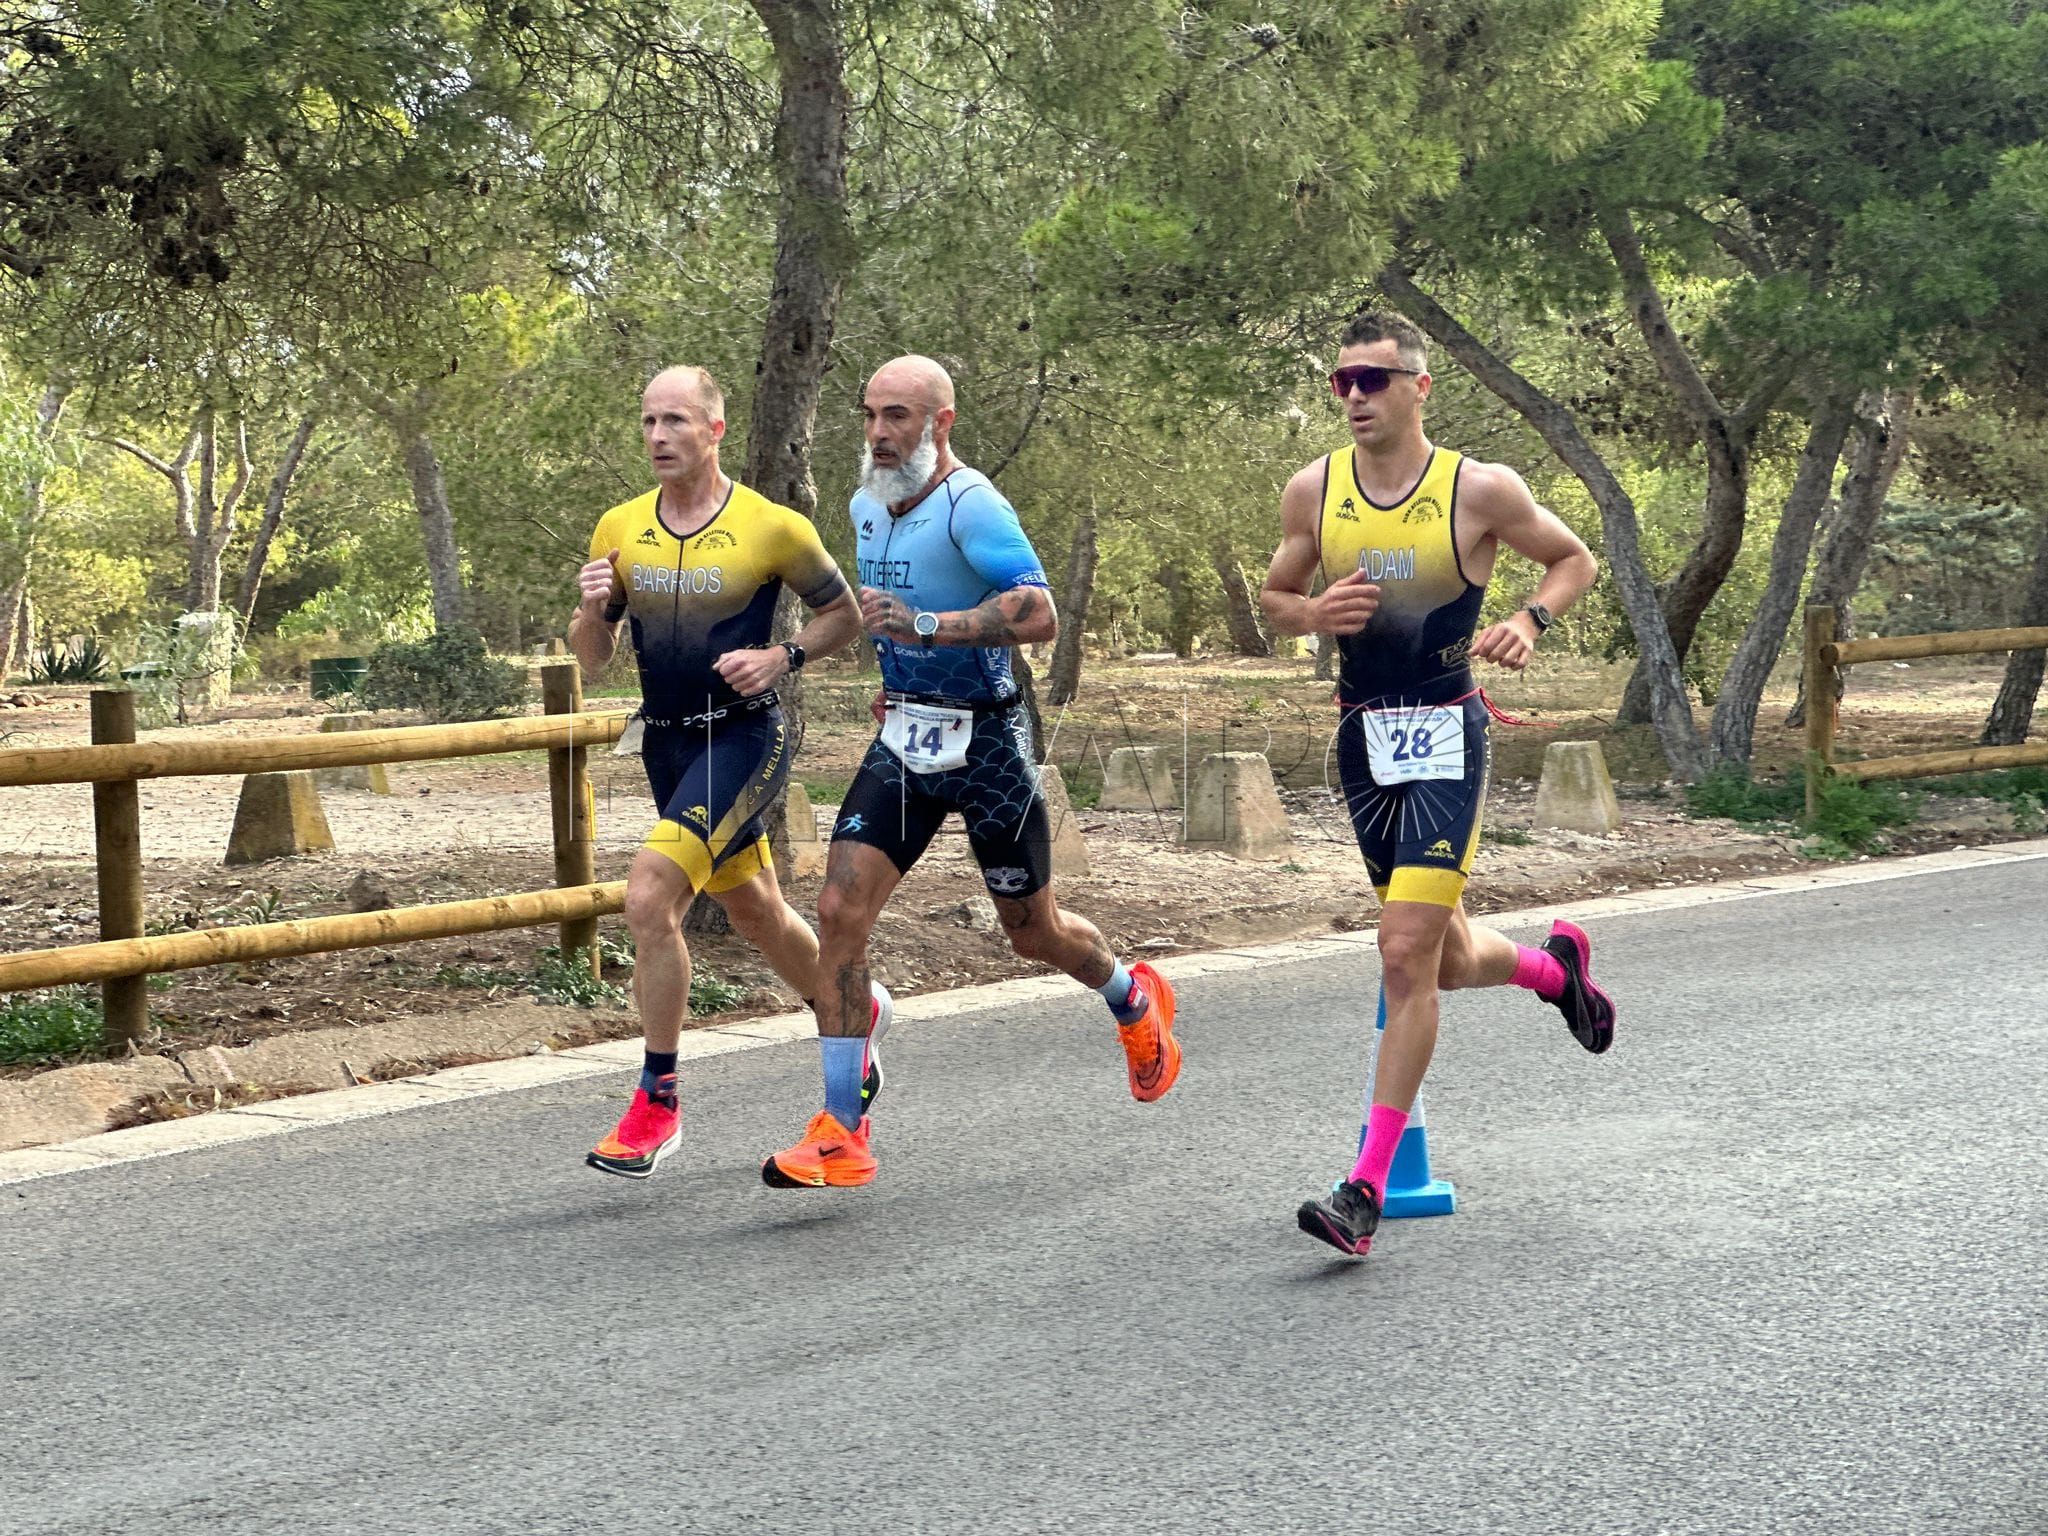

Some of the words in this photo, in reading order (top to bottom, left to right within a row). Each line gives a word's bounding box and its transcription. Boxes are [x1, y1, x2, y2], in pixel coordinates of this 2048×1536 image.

[632, 564, 722, 595] BARRIOS
[1358, 548, 1415, 581] ADAM
[682, 708, 728, 726] orca
[762, 724, 785, 781] MELILLA
[904, 723, 943, 757] 14
[1390, 727, 1433, 762] 28
